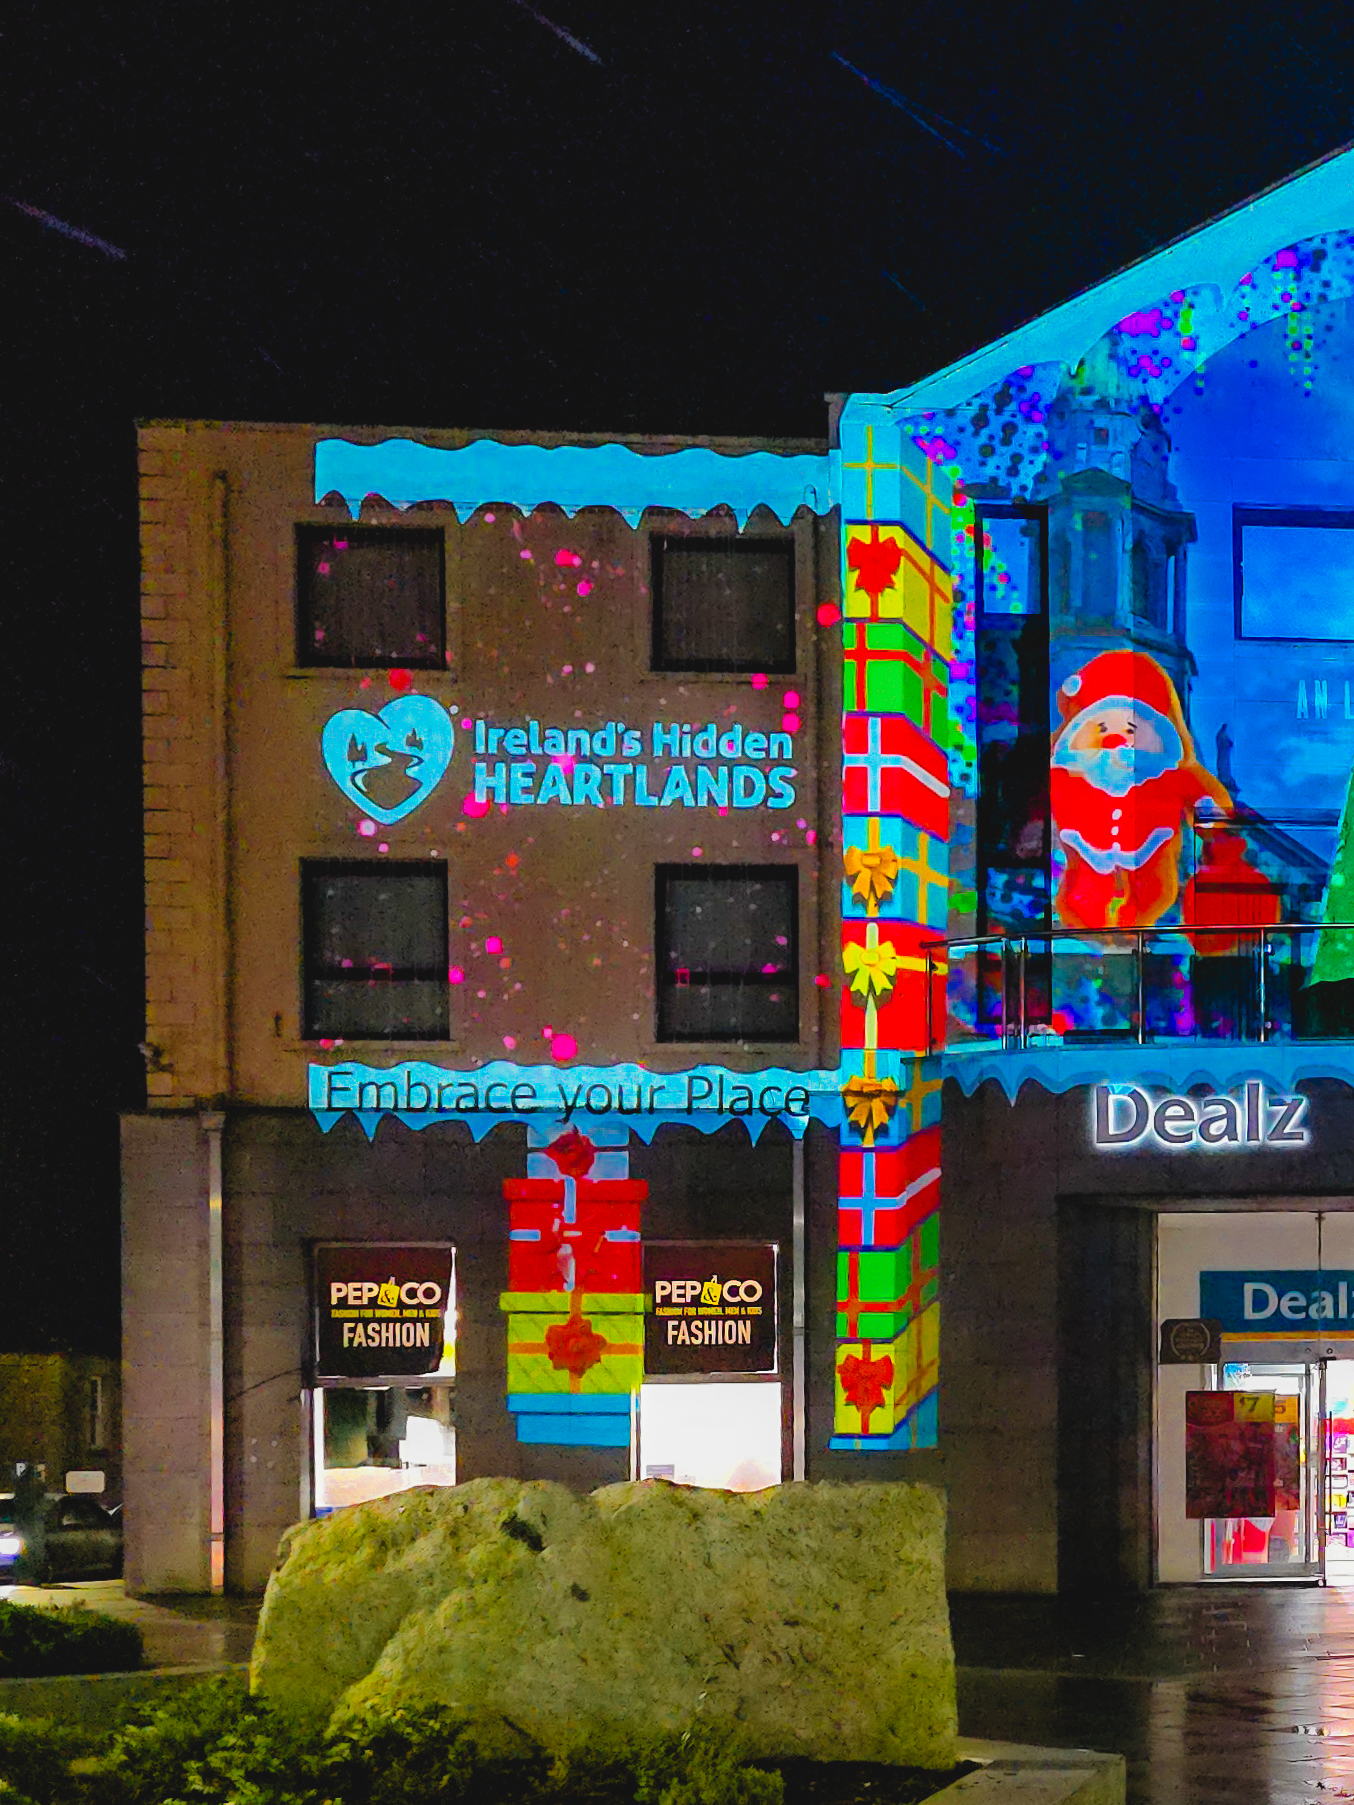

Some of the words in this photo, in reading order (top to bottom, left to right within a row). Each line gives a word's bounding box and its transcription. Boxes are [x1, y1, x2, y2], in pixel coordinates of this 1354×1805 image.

[473, 719, 642, 757] Ireland's
[652, 722, 793, 758] Hidden
[473, 762, 798, 809] HEARTLANDS
[325, 1069, 537, 1114] Embrace
[557, 1080, 666, 1124] your
[686, 1073, 811, 1117] Place
[1095, 1081, 1306, 1145] Dealz
[343, 1322, 431, 1348] FASHION
[666, 1320, 752, 1345] FASHION
